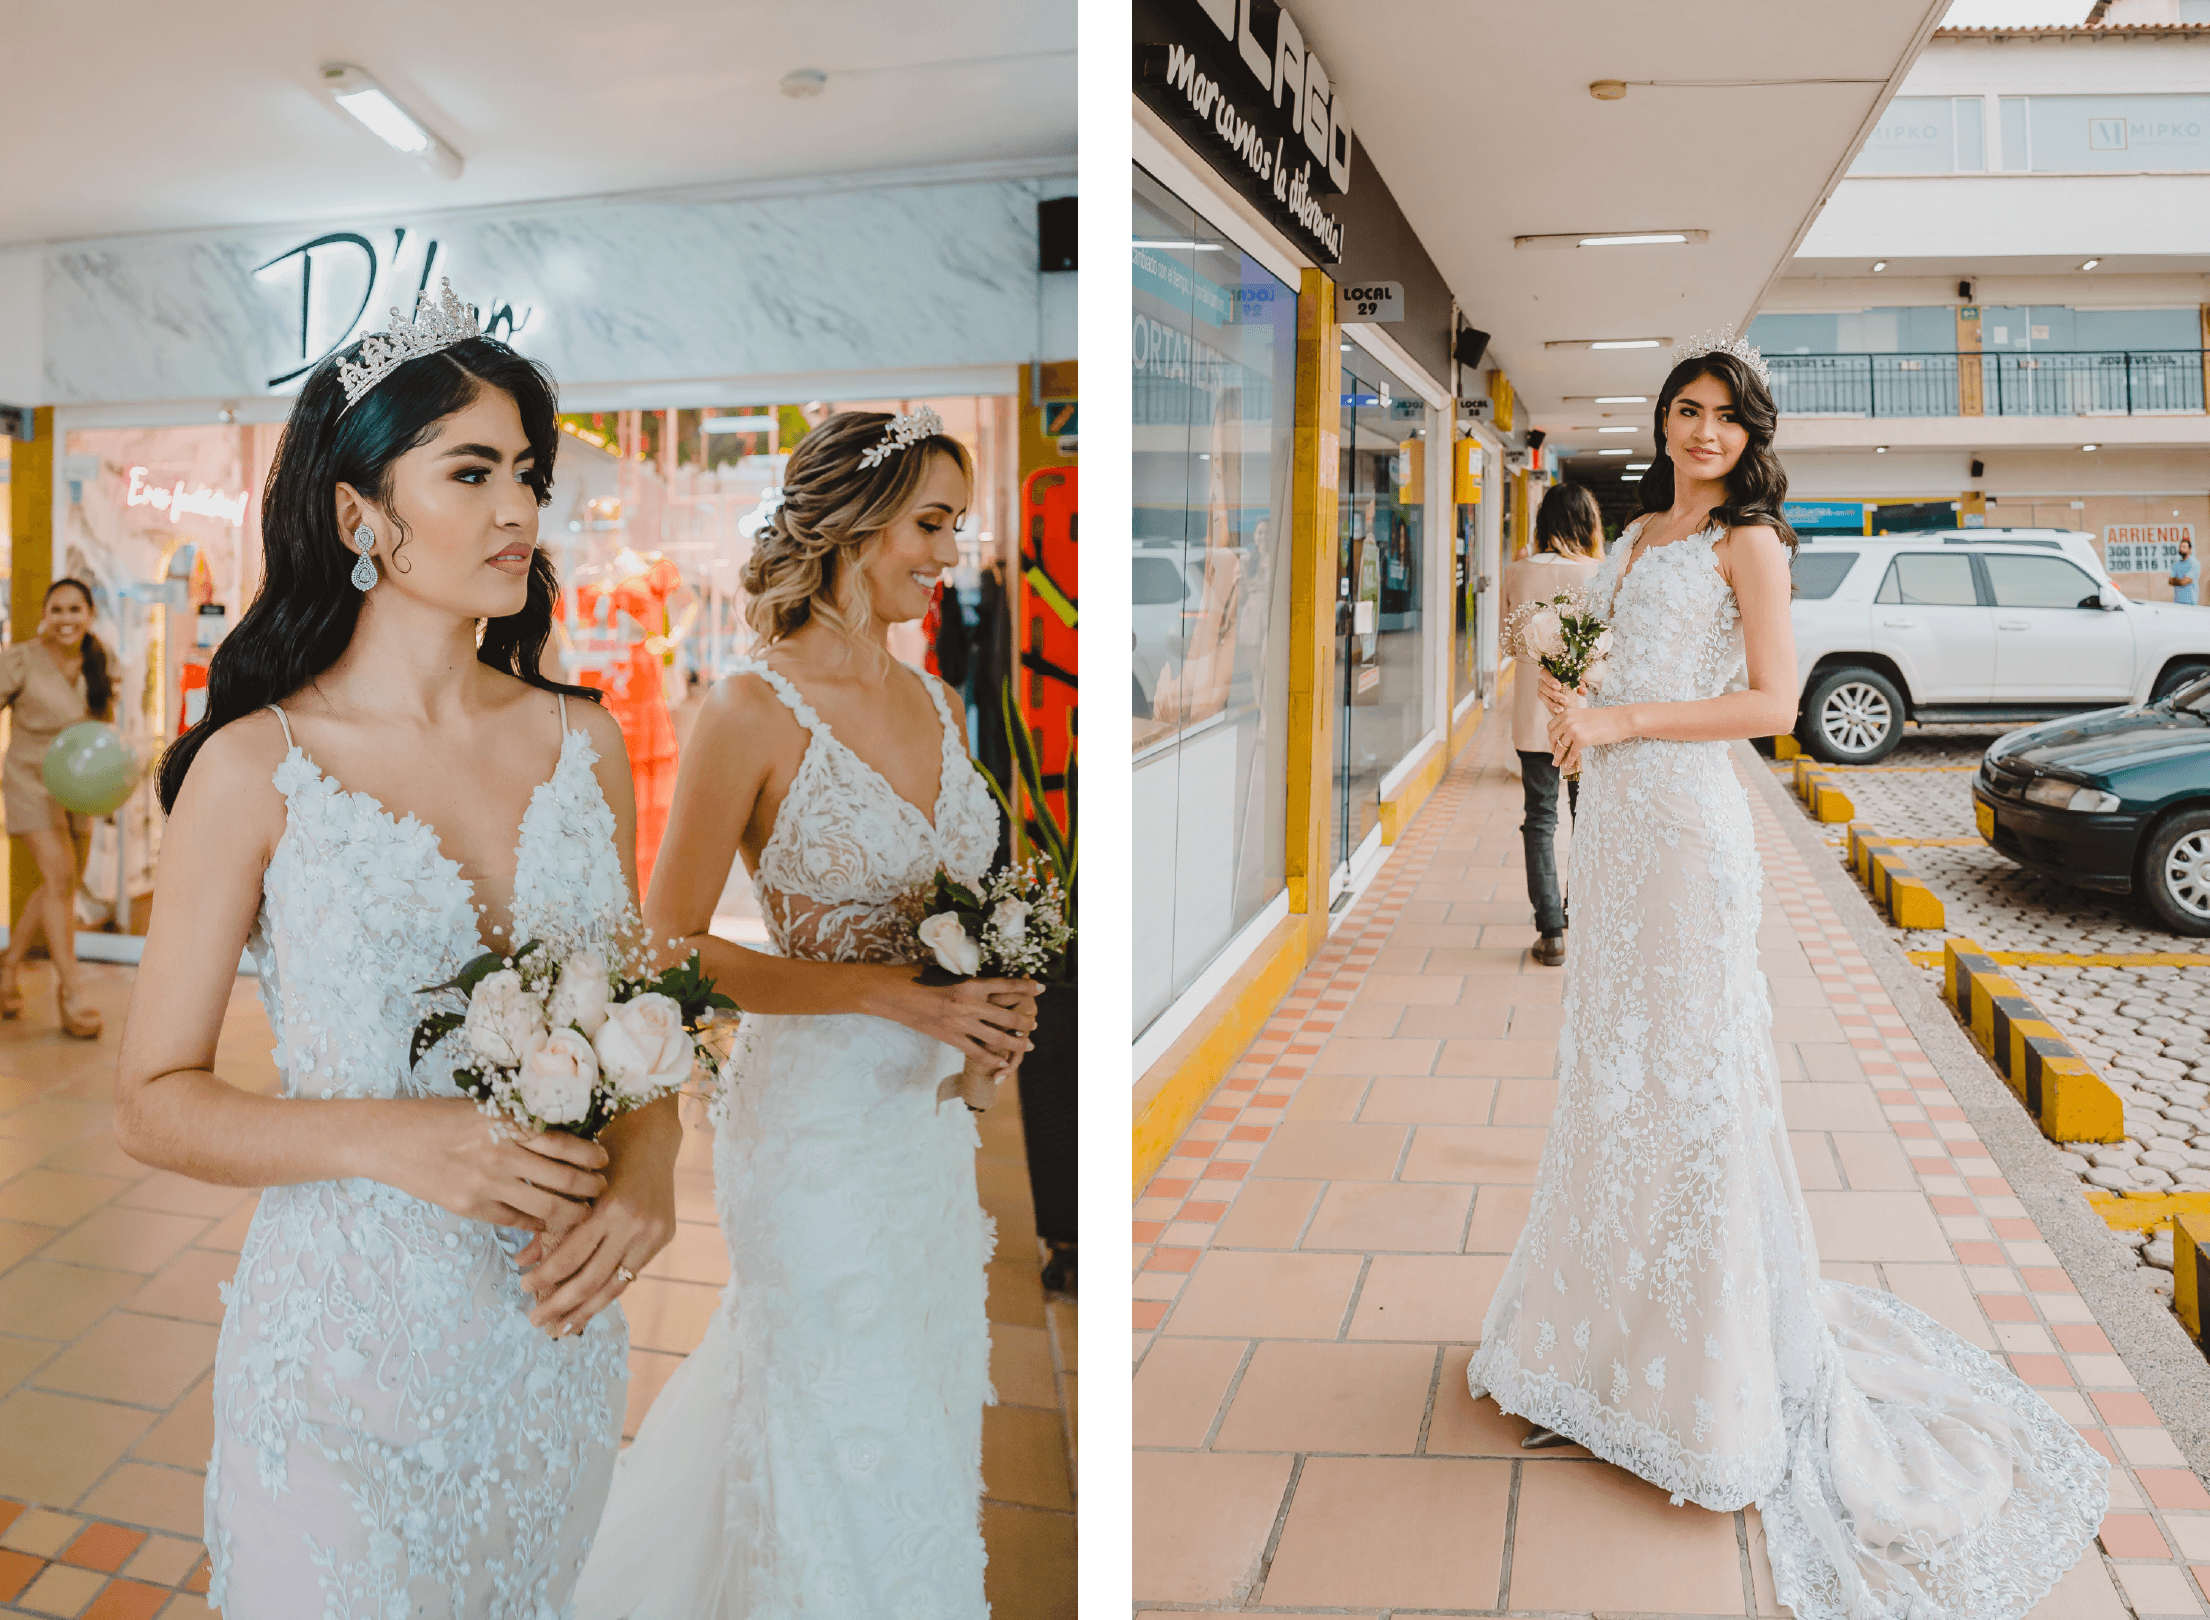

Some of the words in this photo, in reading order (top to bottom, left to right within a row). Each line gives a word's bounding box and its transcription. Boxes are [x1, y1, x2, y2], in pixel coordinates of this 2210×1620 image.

[1196, 0, 1352, 195] LAGO
[2129, 122, 2201, 138] MIPKO
[1273, 137, 1287, 202] la
[1289, 160, 1344, 264] diferencia!
[1343, 287, 1392, 301] LOCAL
[1357, 303, 1378, 315] 29
[1460, 400, 1488, 408] LOCAL
[2108, 527, 2191, 543] ARRIENDA
[2108, 546, 2131, 557] 300
[2135, 546, 2157, 557] 817
[2108, 560, 2131, 570] 300
[2136, 560, 2158, 570] 816
